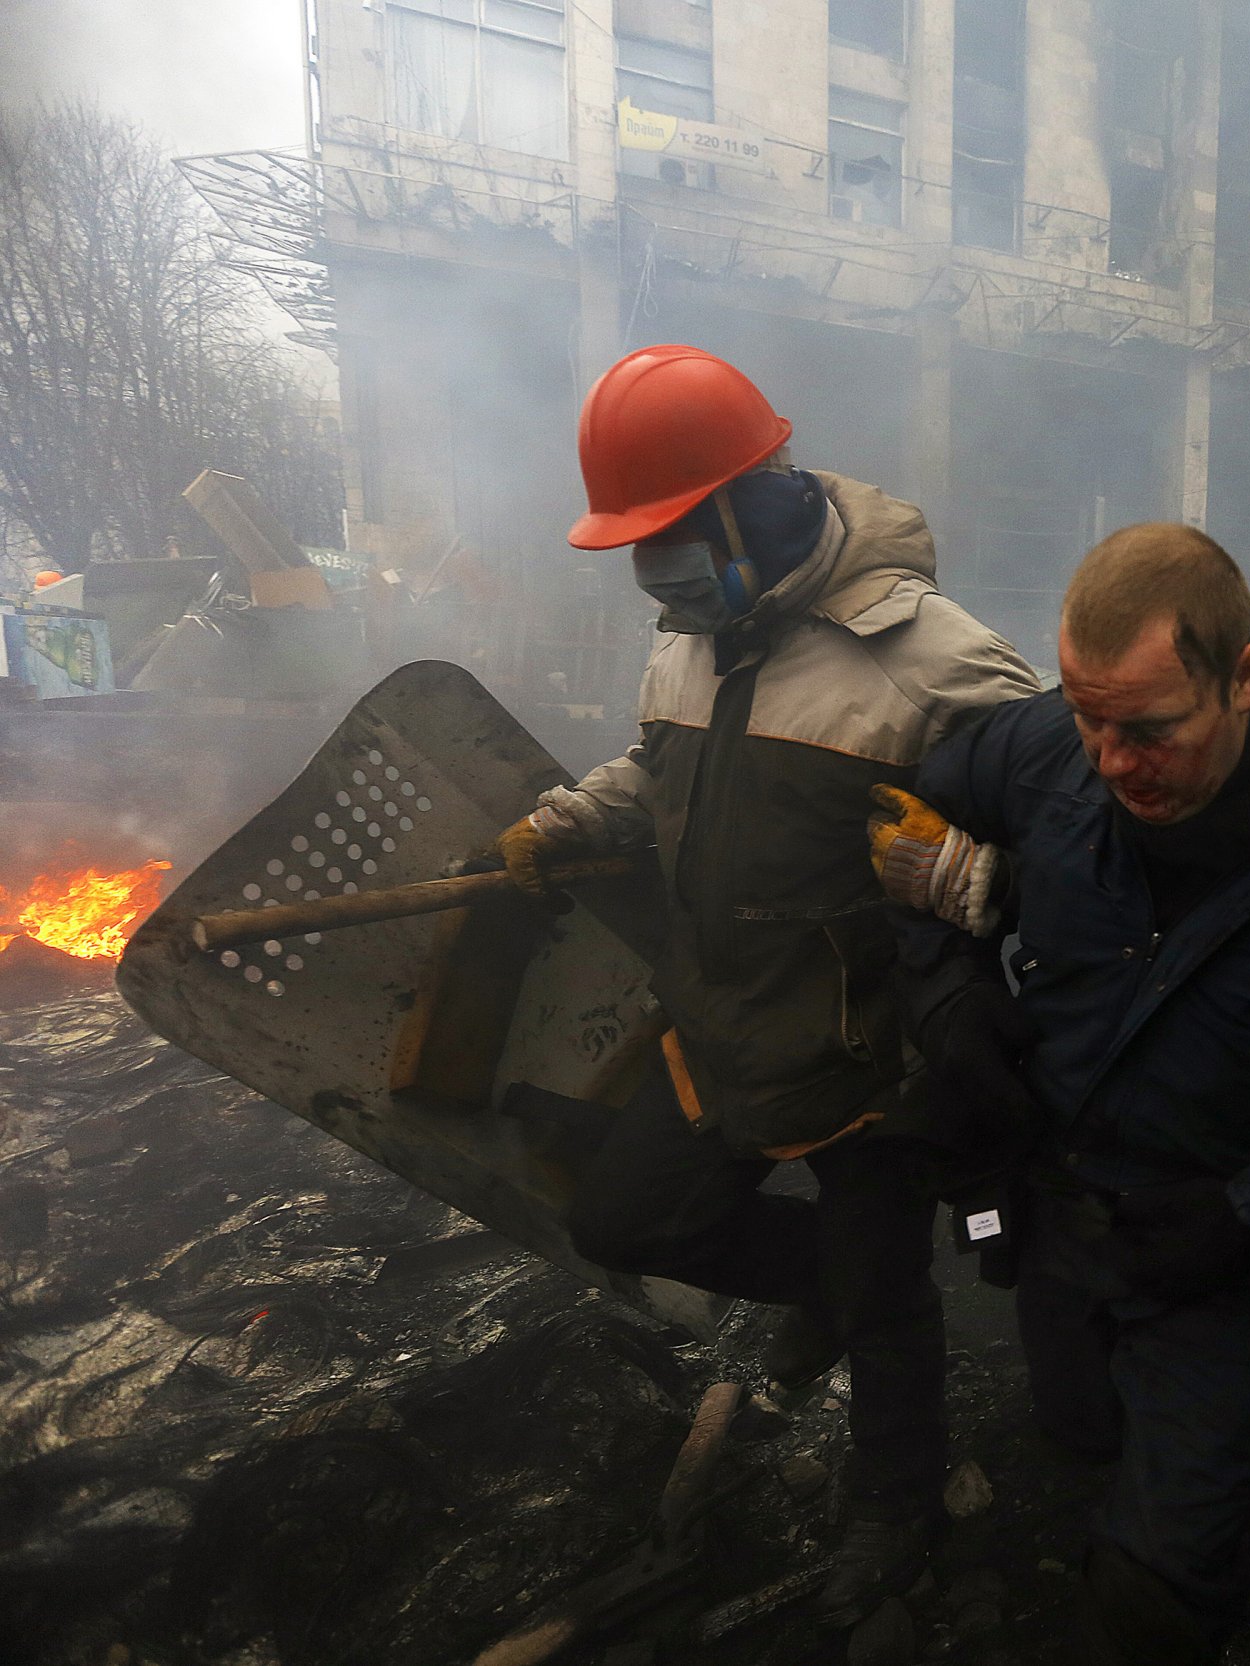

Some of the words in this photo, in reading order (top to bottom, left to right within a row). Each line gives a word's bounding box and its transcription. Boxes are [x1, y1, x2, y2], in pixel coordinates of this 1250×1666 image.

[694, 132, 720, 149] 220
[724, 138, 738, 153] 11
[743, 143, 759, 157] 99
